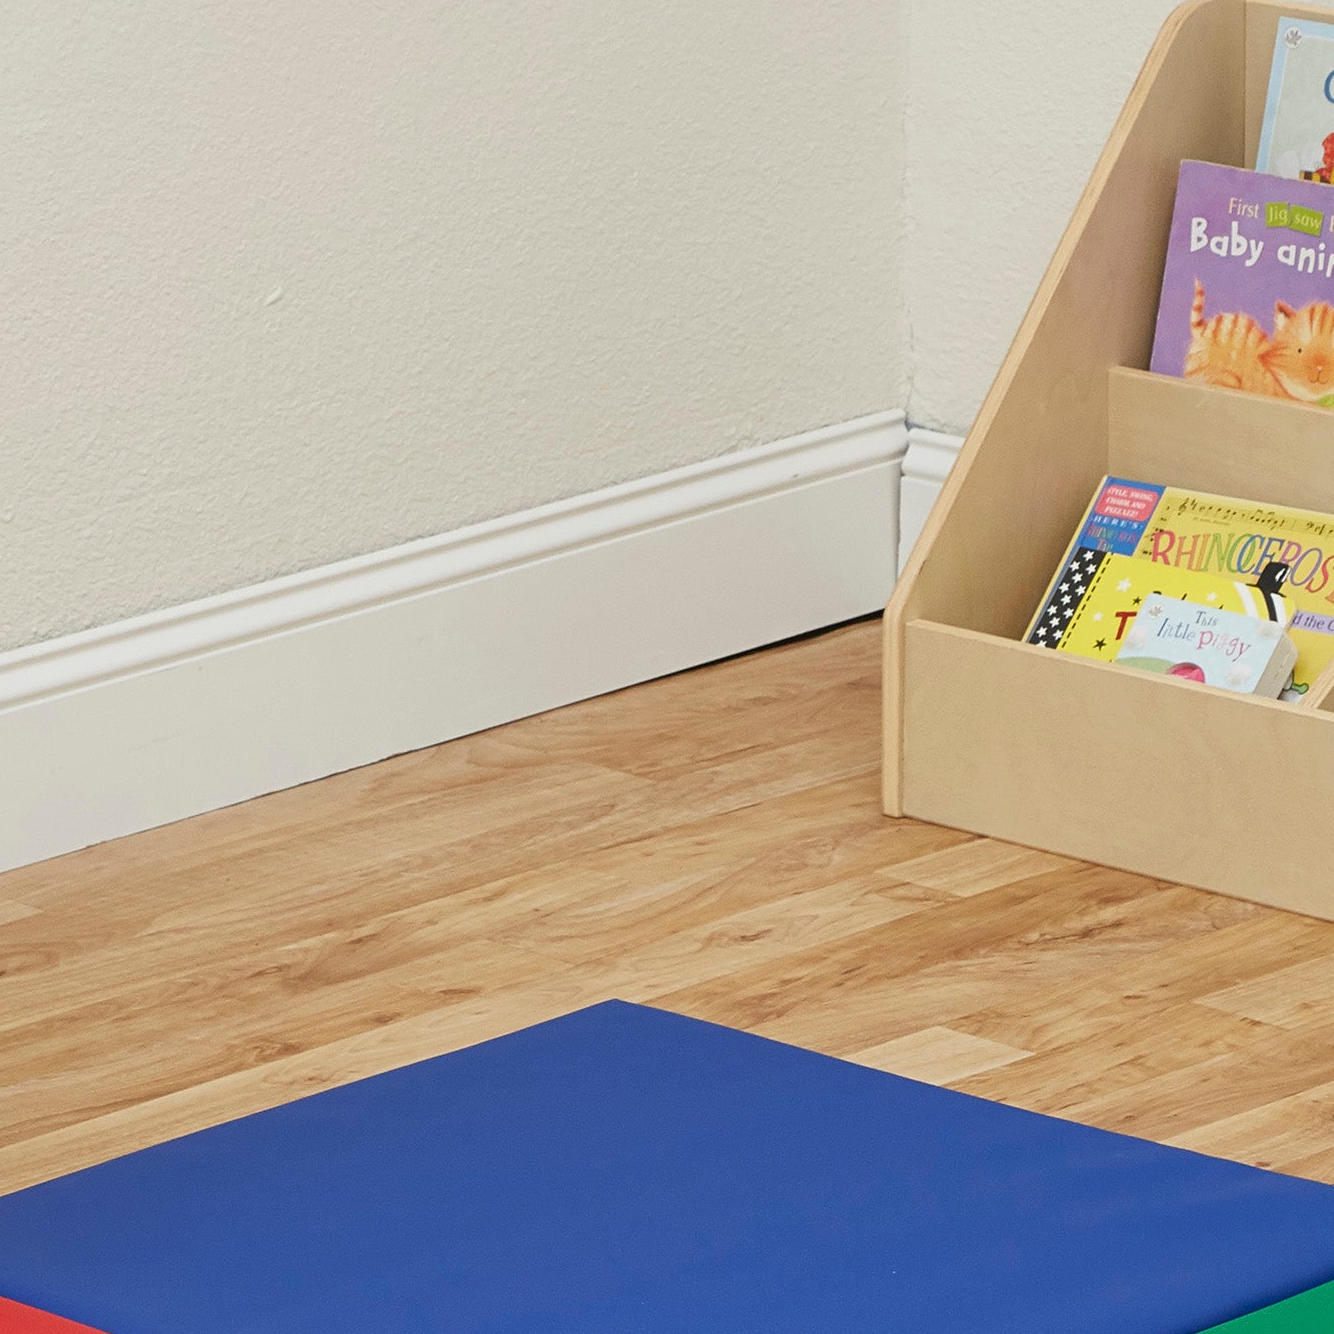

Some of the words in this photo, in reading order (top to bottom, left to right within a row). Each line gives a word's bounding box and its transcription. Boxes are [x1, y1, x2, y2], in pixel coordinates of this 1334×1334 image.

[1228, 197, 1260, 218] First
[1190, 217, 1264, 267] Baby
[1195, 610, 1218, 627] This
[1304, 615, 1325, 629] the
[1156, 618, 1196, 642] little
[1196, 630, 1251, 663] piggy
